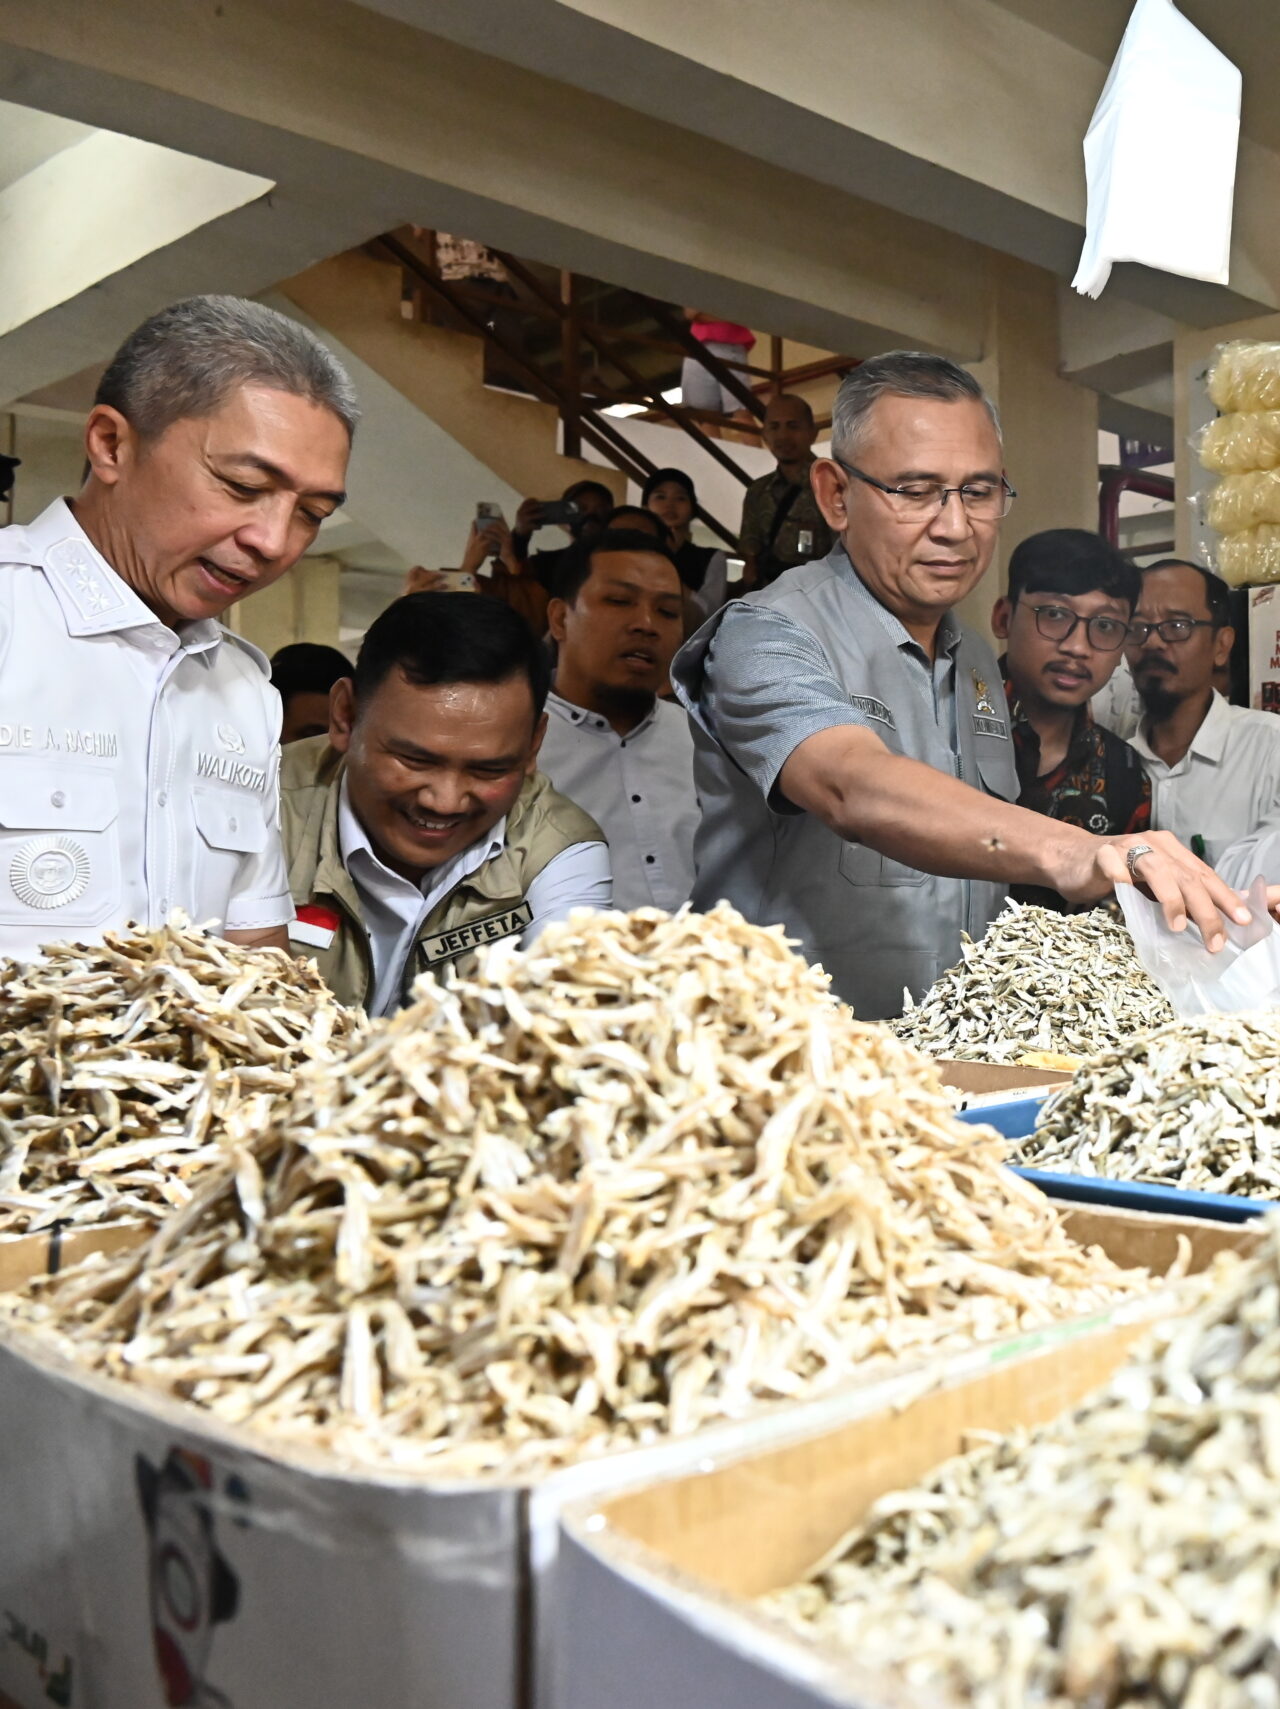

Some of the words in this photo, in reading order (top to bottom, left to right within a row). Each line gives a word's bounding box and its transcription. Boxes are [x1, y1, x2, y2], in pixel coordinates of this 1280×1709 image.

[64, 730, 118, 758] RACHIM
[195, 751, 267, 793] WALIKOTA
[434, 910, 525, 957] JEFFETA
